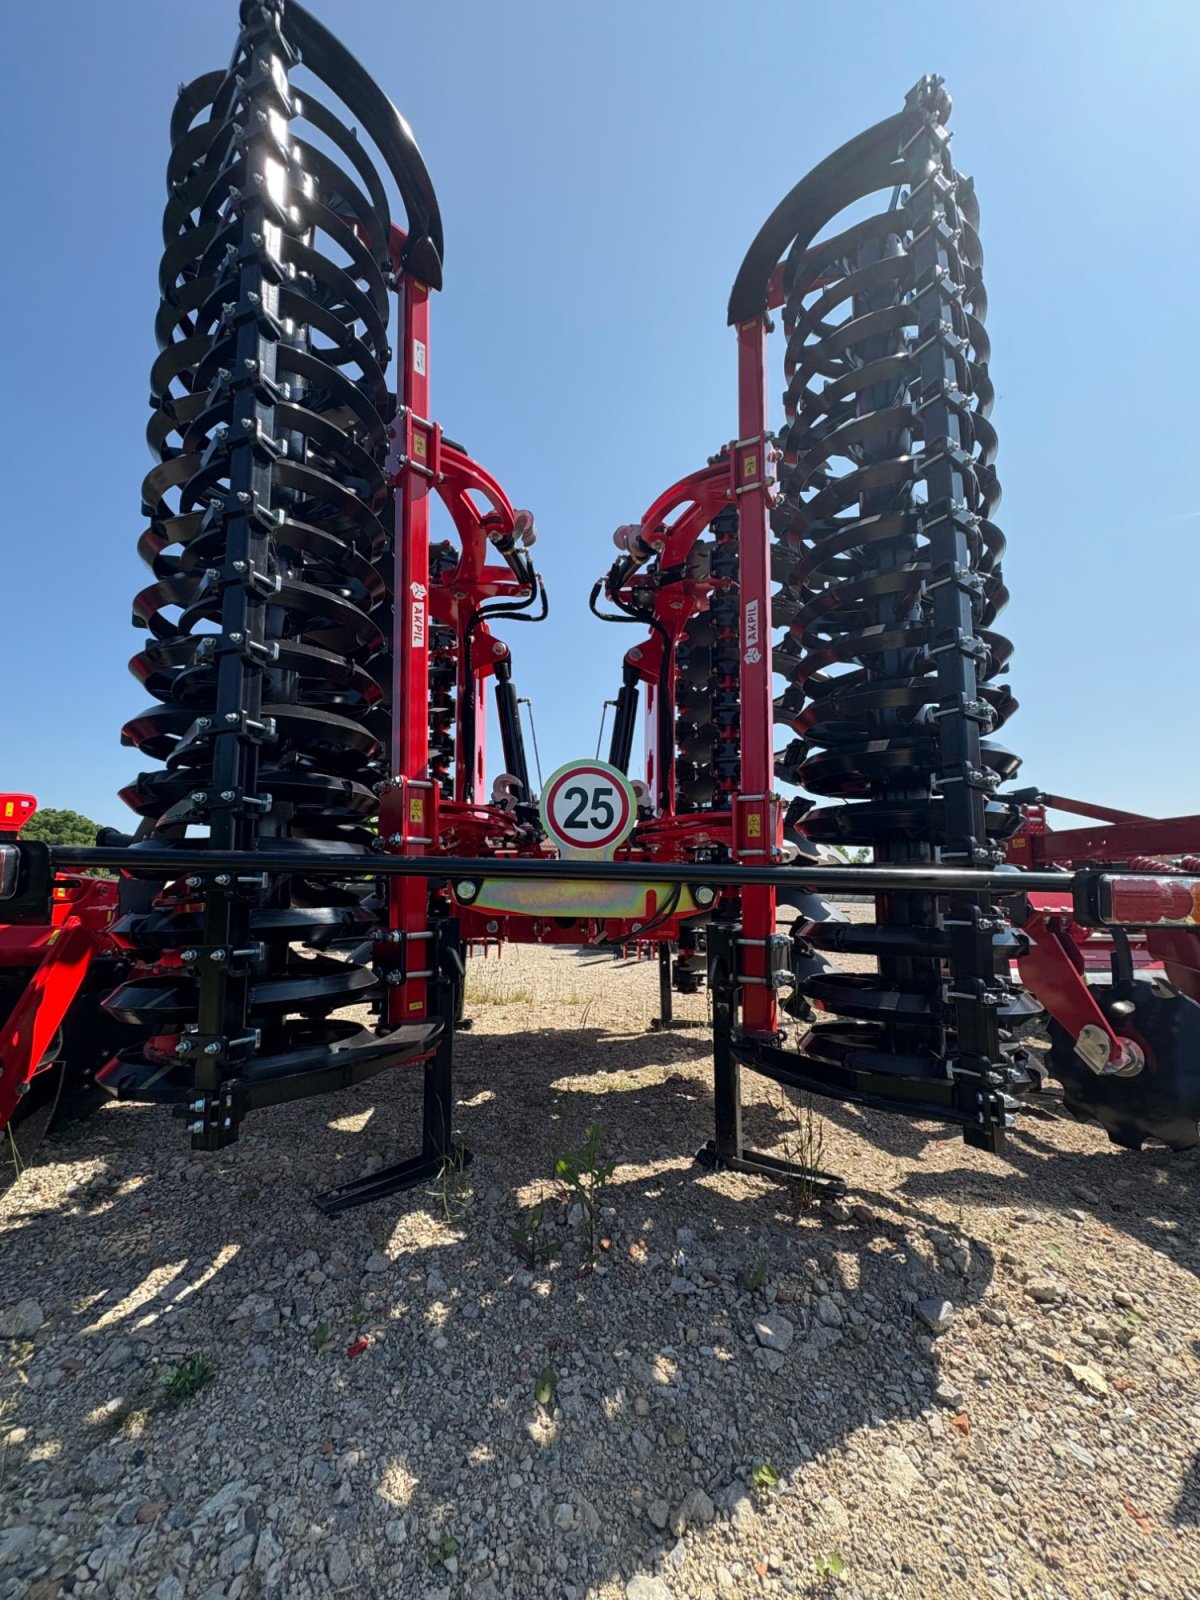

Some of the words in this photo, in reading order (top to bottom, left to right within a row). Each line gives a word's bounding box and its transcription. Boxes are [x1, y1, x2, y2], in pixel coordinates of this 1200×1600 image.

[414, 605, 423, 642] AKPIL
[747, 605, 757, 640] AKPIL
[563, 787, 614, 830] 25
